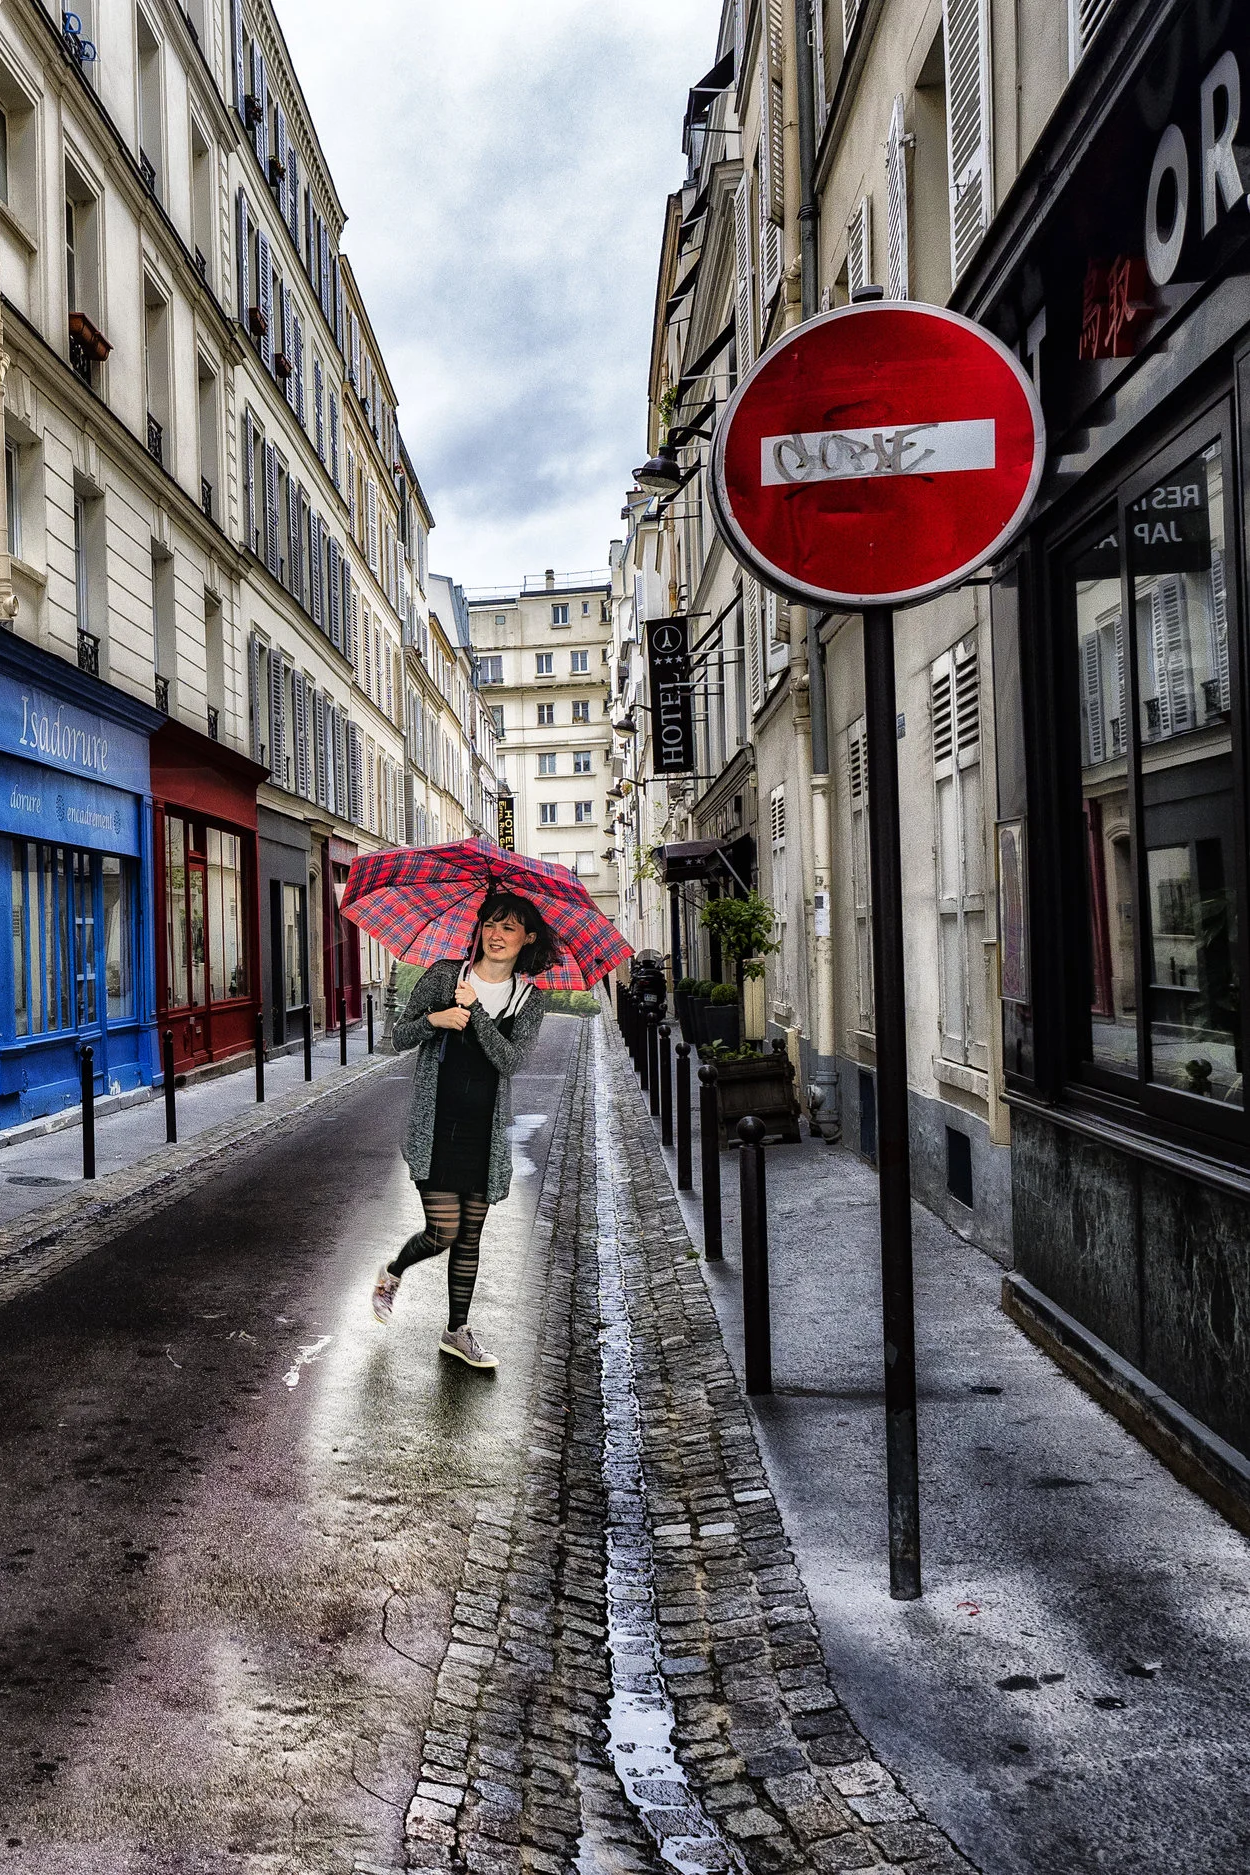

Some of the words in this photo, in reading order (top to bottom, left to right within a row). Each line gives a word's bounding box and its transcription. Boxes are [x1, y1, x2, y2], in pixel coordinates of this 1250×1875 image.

[1145, 50, 1250, 287] OR
[19, 695, 109, 772] Isadorure
[659, 672, 684, 766] HOTEL
[10, 783, 42, 814] dorure
[66, 803, 114, 831] encadrement
[505, 810, 514, 851] HOTEL
